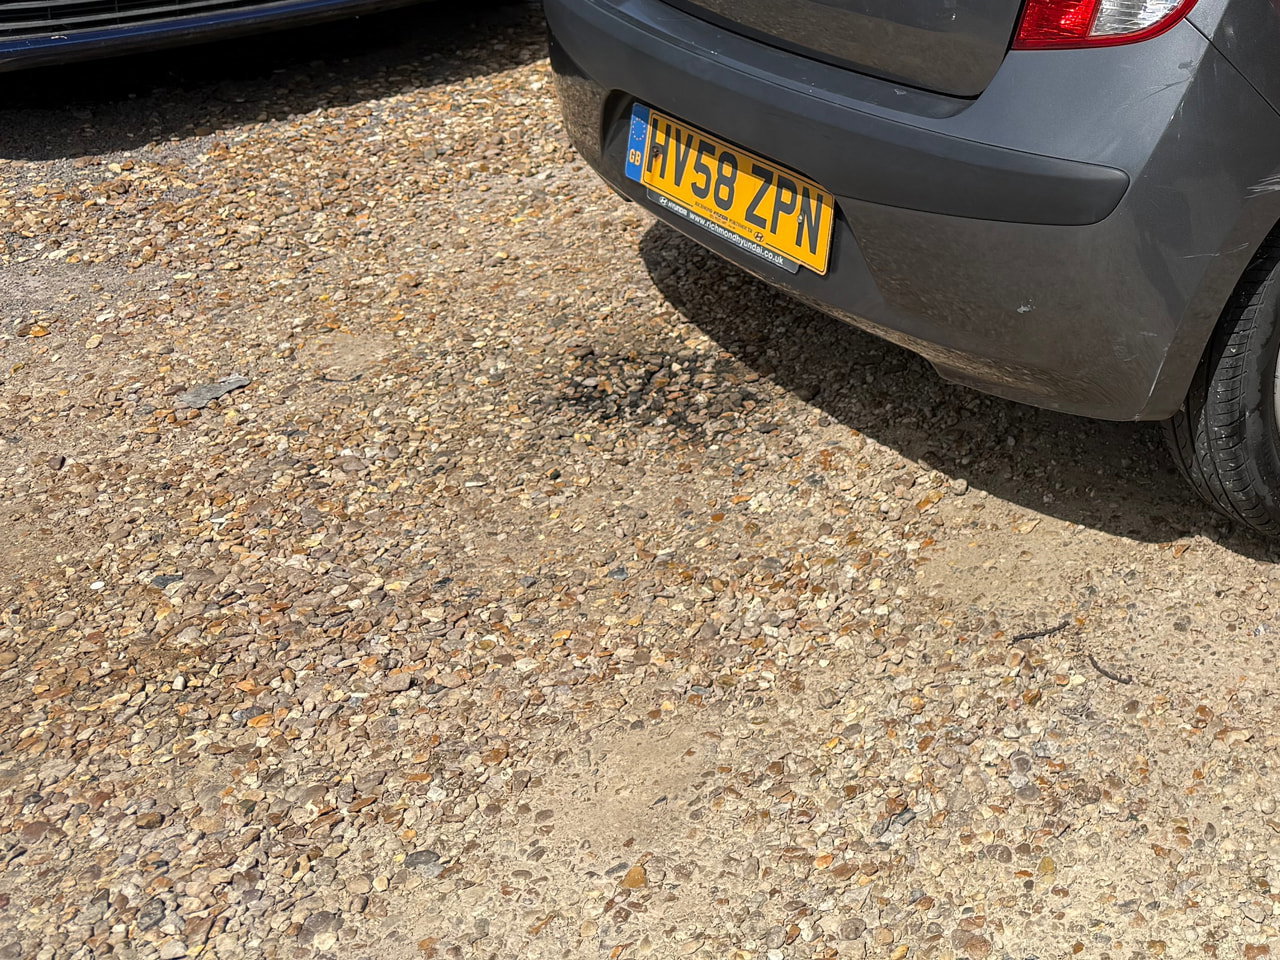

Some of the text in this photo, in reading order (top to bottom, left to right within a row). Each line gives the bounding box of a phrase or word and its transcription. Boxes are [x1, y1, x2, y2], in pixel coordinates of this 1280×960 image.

[629, 148, 642, 167] GB
[646, 117, 824, 256] HV58 ZPN
[689, 207, 784, 266] www.richmondhyundai.co.uk
